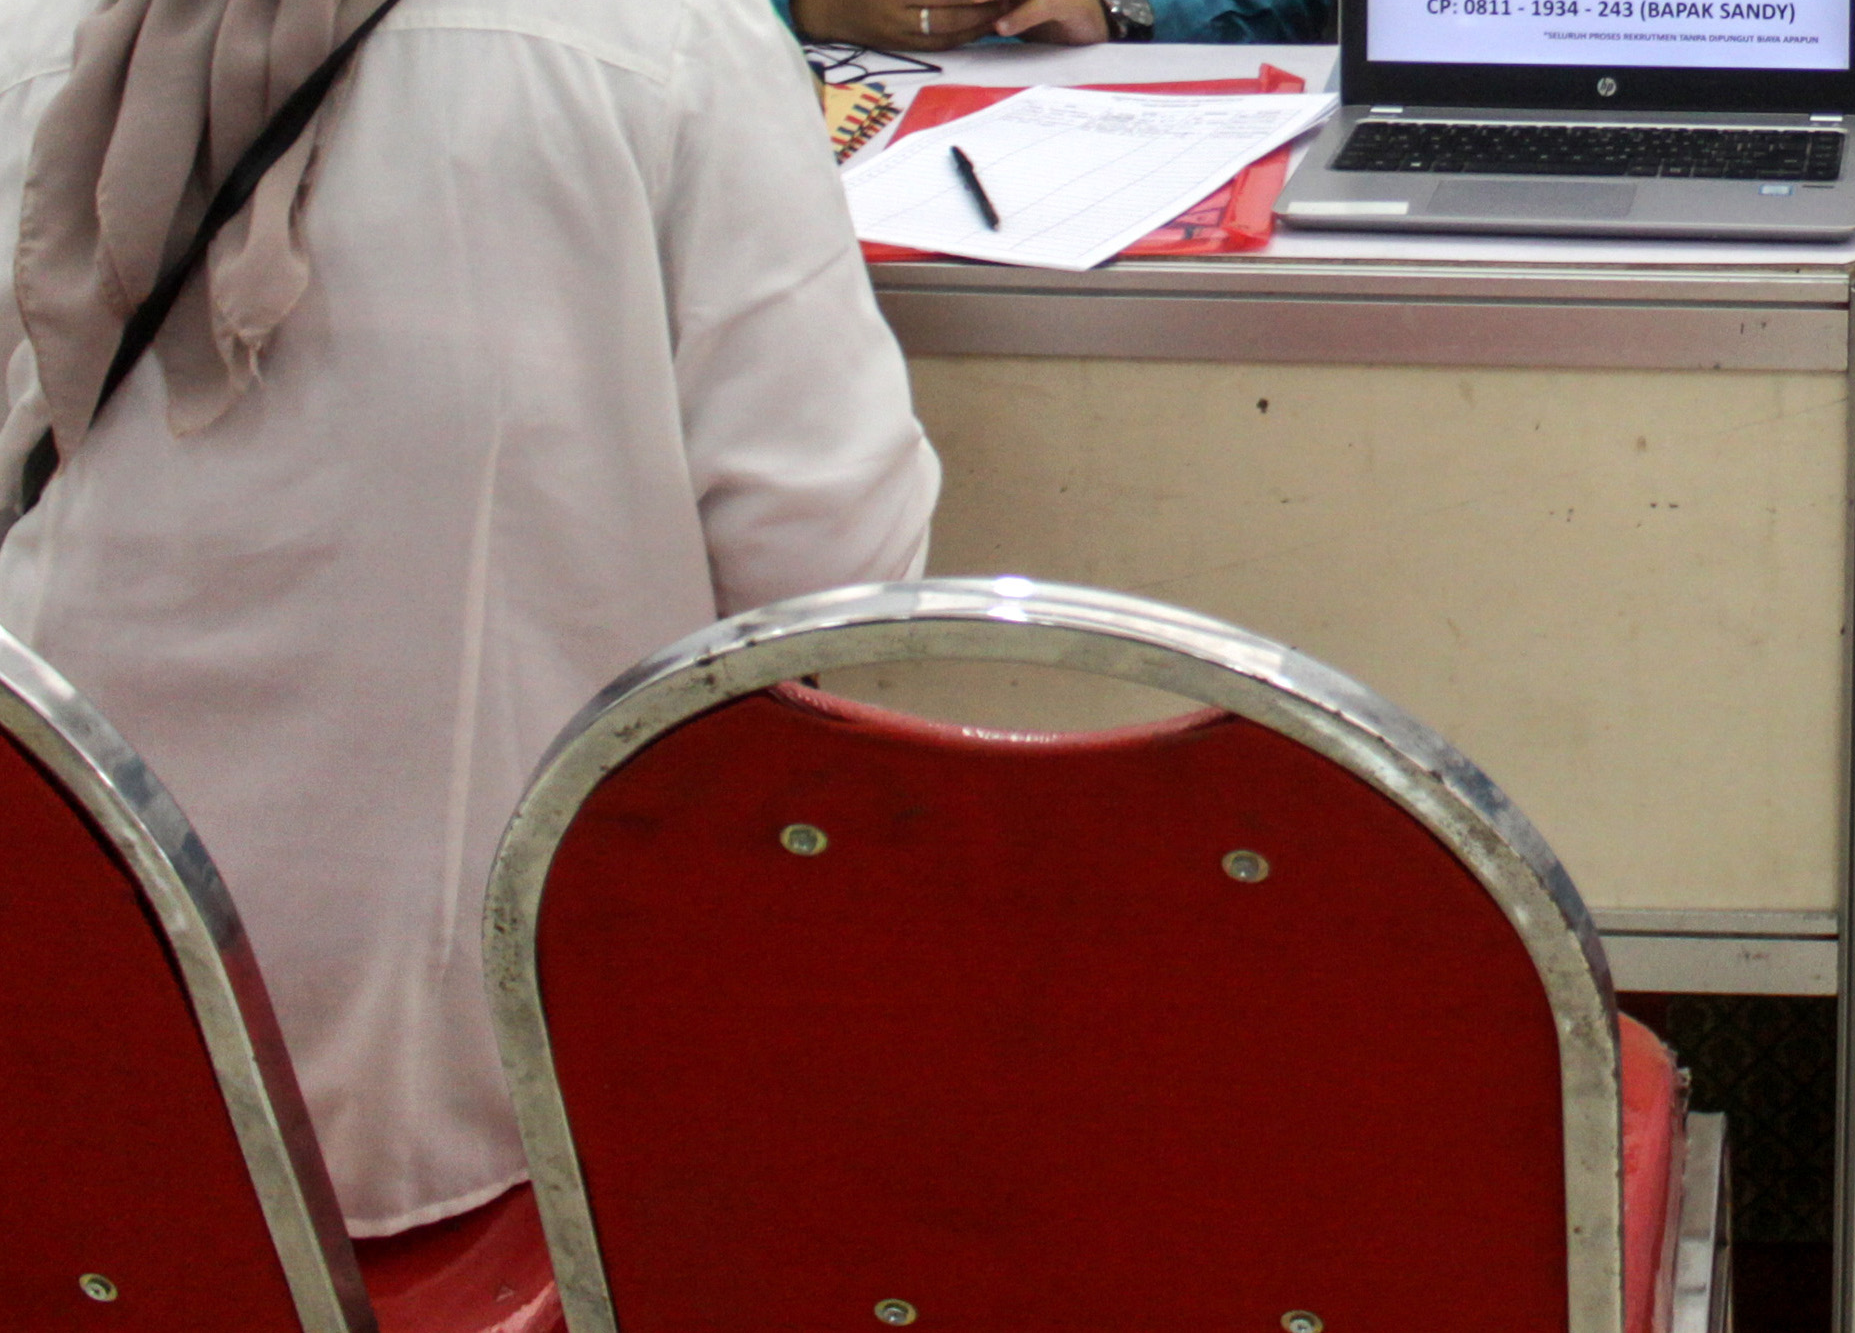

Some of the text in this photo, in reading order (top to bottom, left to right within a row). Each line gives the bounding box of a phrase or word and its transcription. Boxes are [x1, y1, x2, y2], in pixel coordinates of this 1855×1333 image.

[1464, 0, 1795, 24] 0811 1934 243 (BAPAK SANDY)
